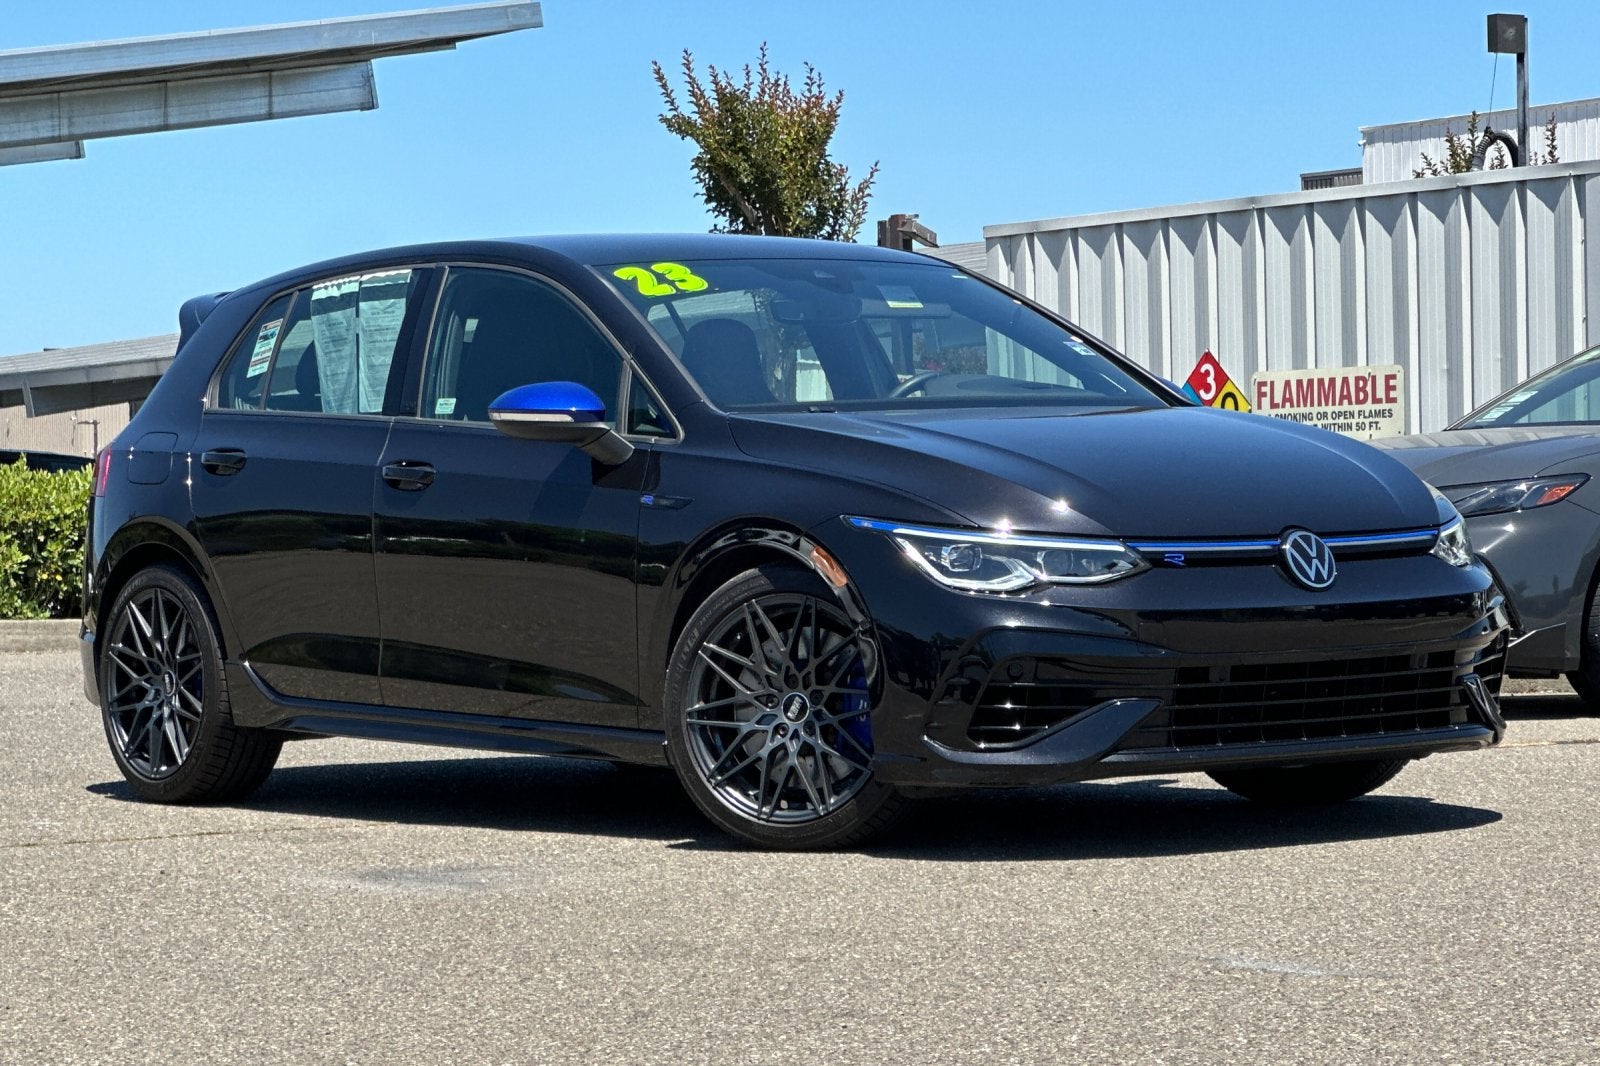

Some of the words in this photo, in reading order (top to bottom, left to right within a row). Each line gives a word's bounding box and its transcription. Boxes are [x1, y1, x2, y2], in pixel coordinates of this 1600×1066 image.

[613, 262, 708, 297] 23
[1199, 363, 1217, 401] 3
[1256, 374, 1397, 410] FLAMMABLE
[1316, 411, 1329, 421] OR
[1331, 410, 1355, 420] OPEN
[1357, 409, 1393, 419] FLAMES
[1321, 422, 1353, 432] WITHIN
[1355, 421, 1366, 431] 50
[1368, 421, 1382, 431] FT.
